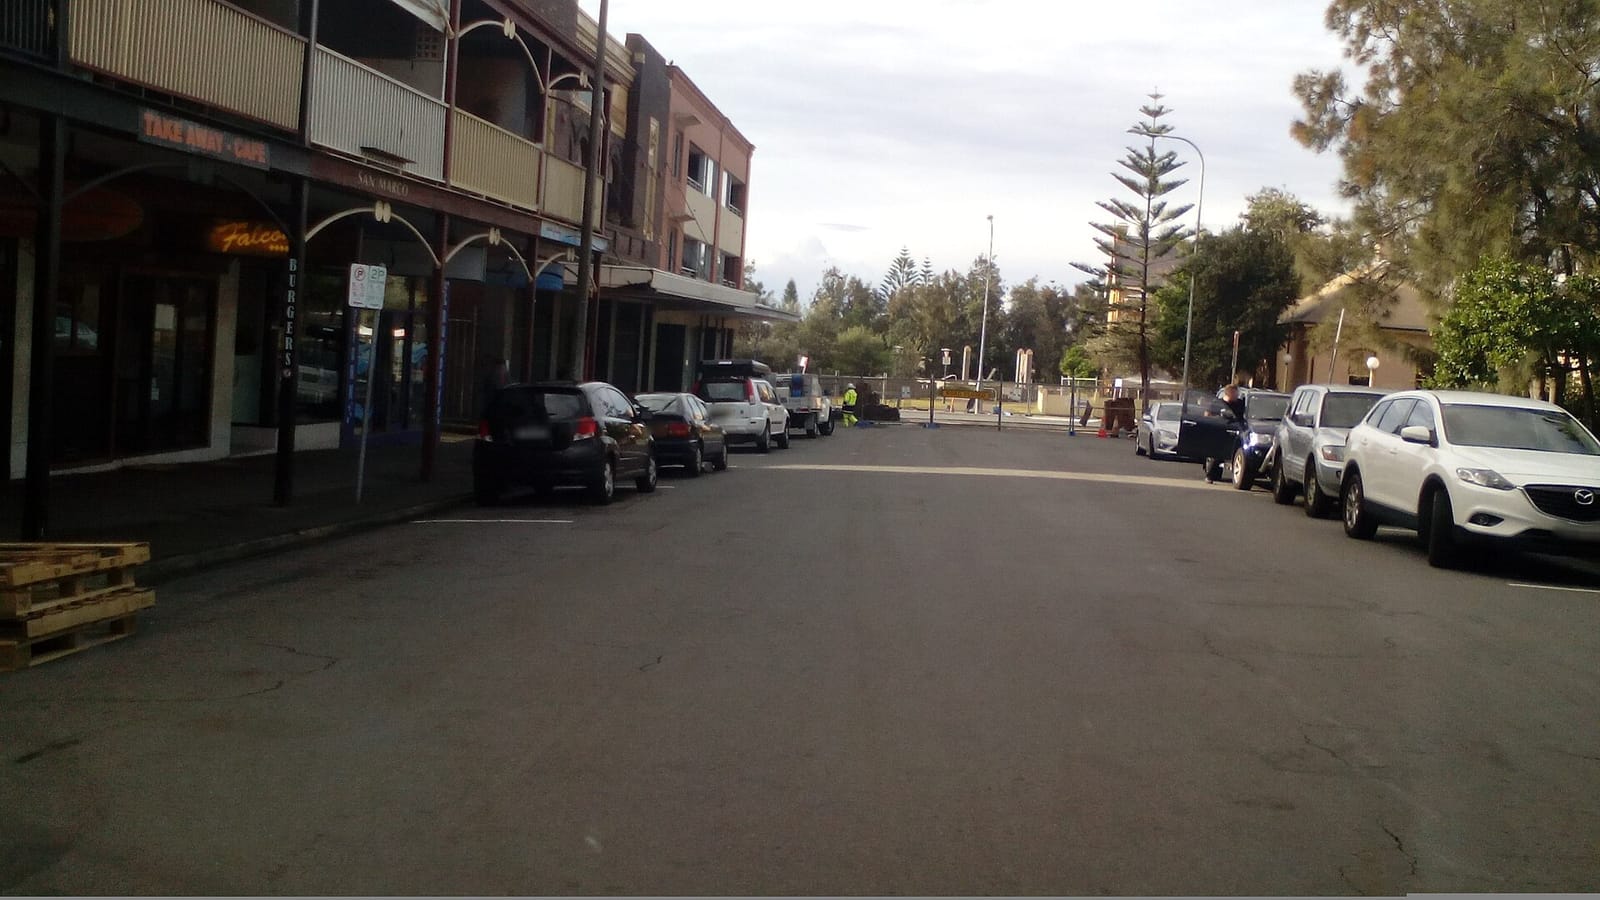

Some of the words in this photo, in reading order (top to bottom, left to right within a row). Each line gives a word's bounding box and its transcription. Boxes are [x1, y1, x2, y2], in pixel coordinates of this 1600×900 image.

[143, 111, 183, 143] TAKE
[185, 125, 225, 154] AWAY
[379, 179, 409, 197] MARCO
[370, 268, 385, 280] 2P
[285, 258, 297, 367] BURGERS
